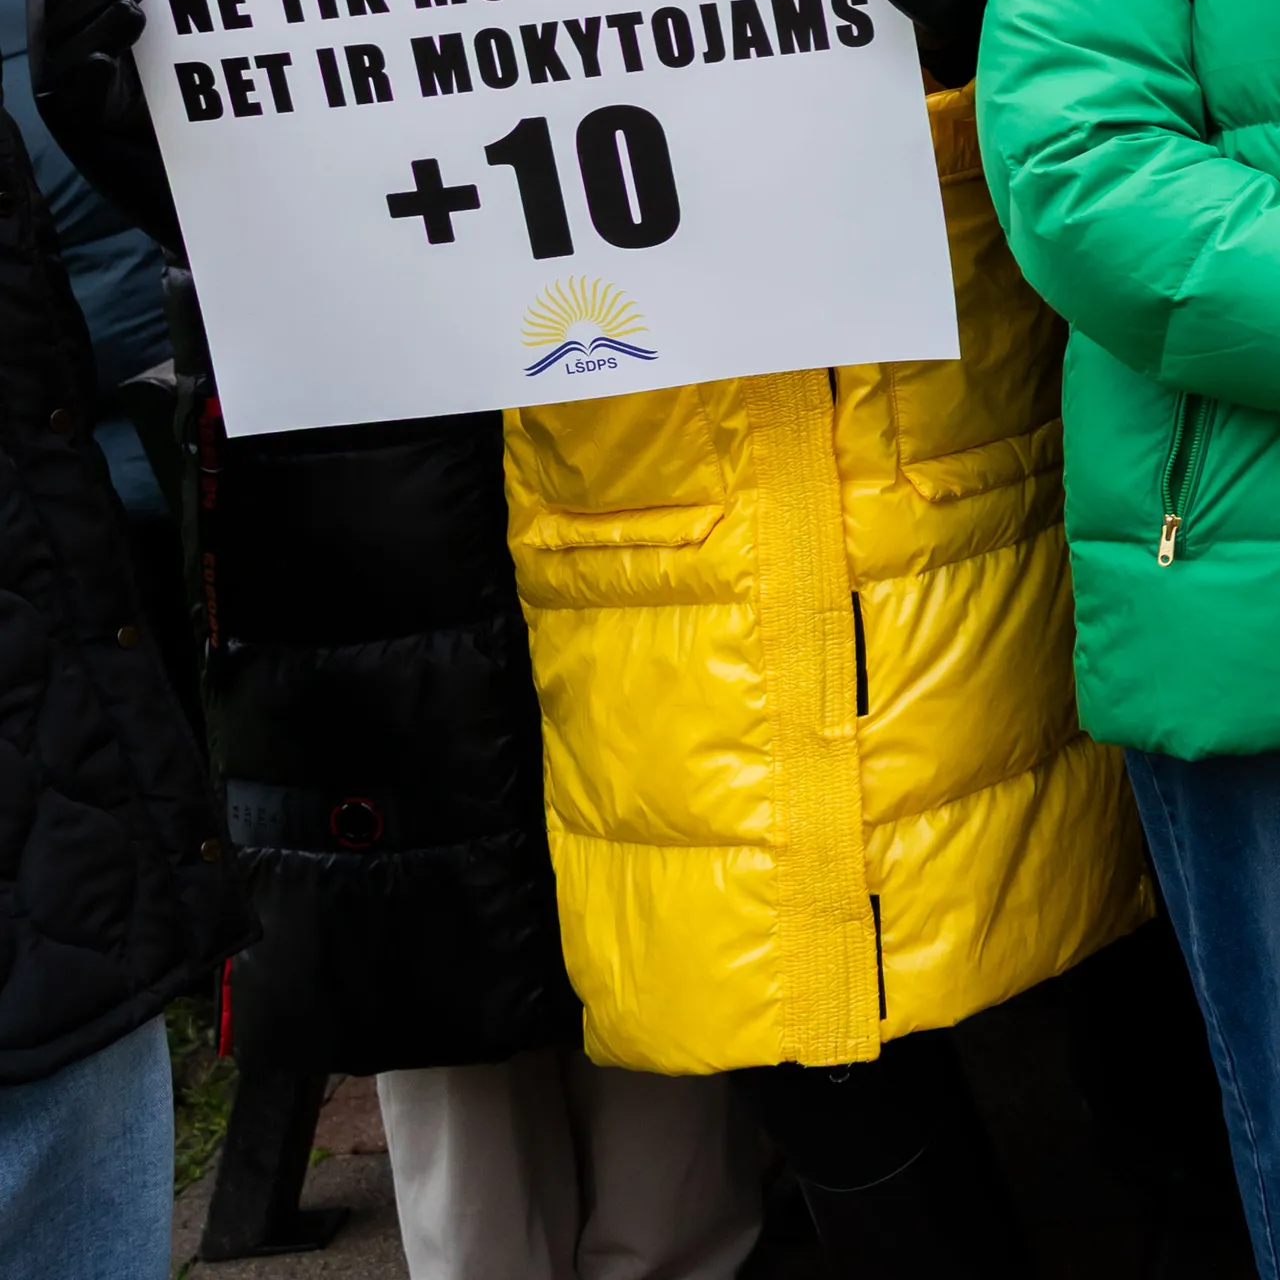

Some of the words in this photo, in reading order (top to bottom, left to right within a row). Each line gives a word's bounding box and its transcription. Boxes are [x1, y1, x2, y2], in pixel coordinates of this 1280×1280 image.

[173, 52, 295, 123] BET
[315, 43, 394, 108] IR
[385, 104, 681, 260] +10
[565, 356, 618, 375] LŠDPS
